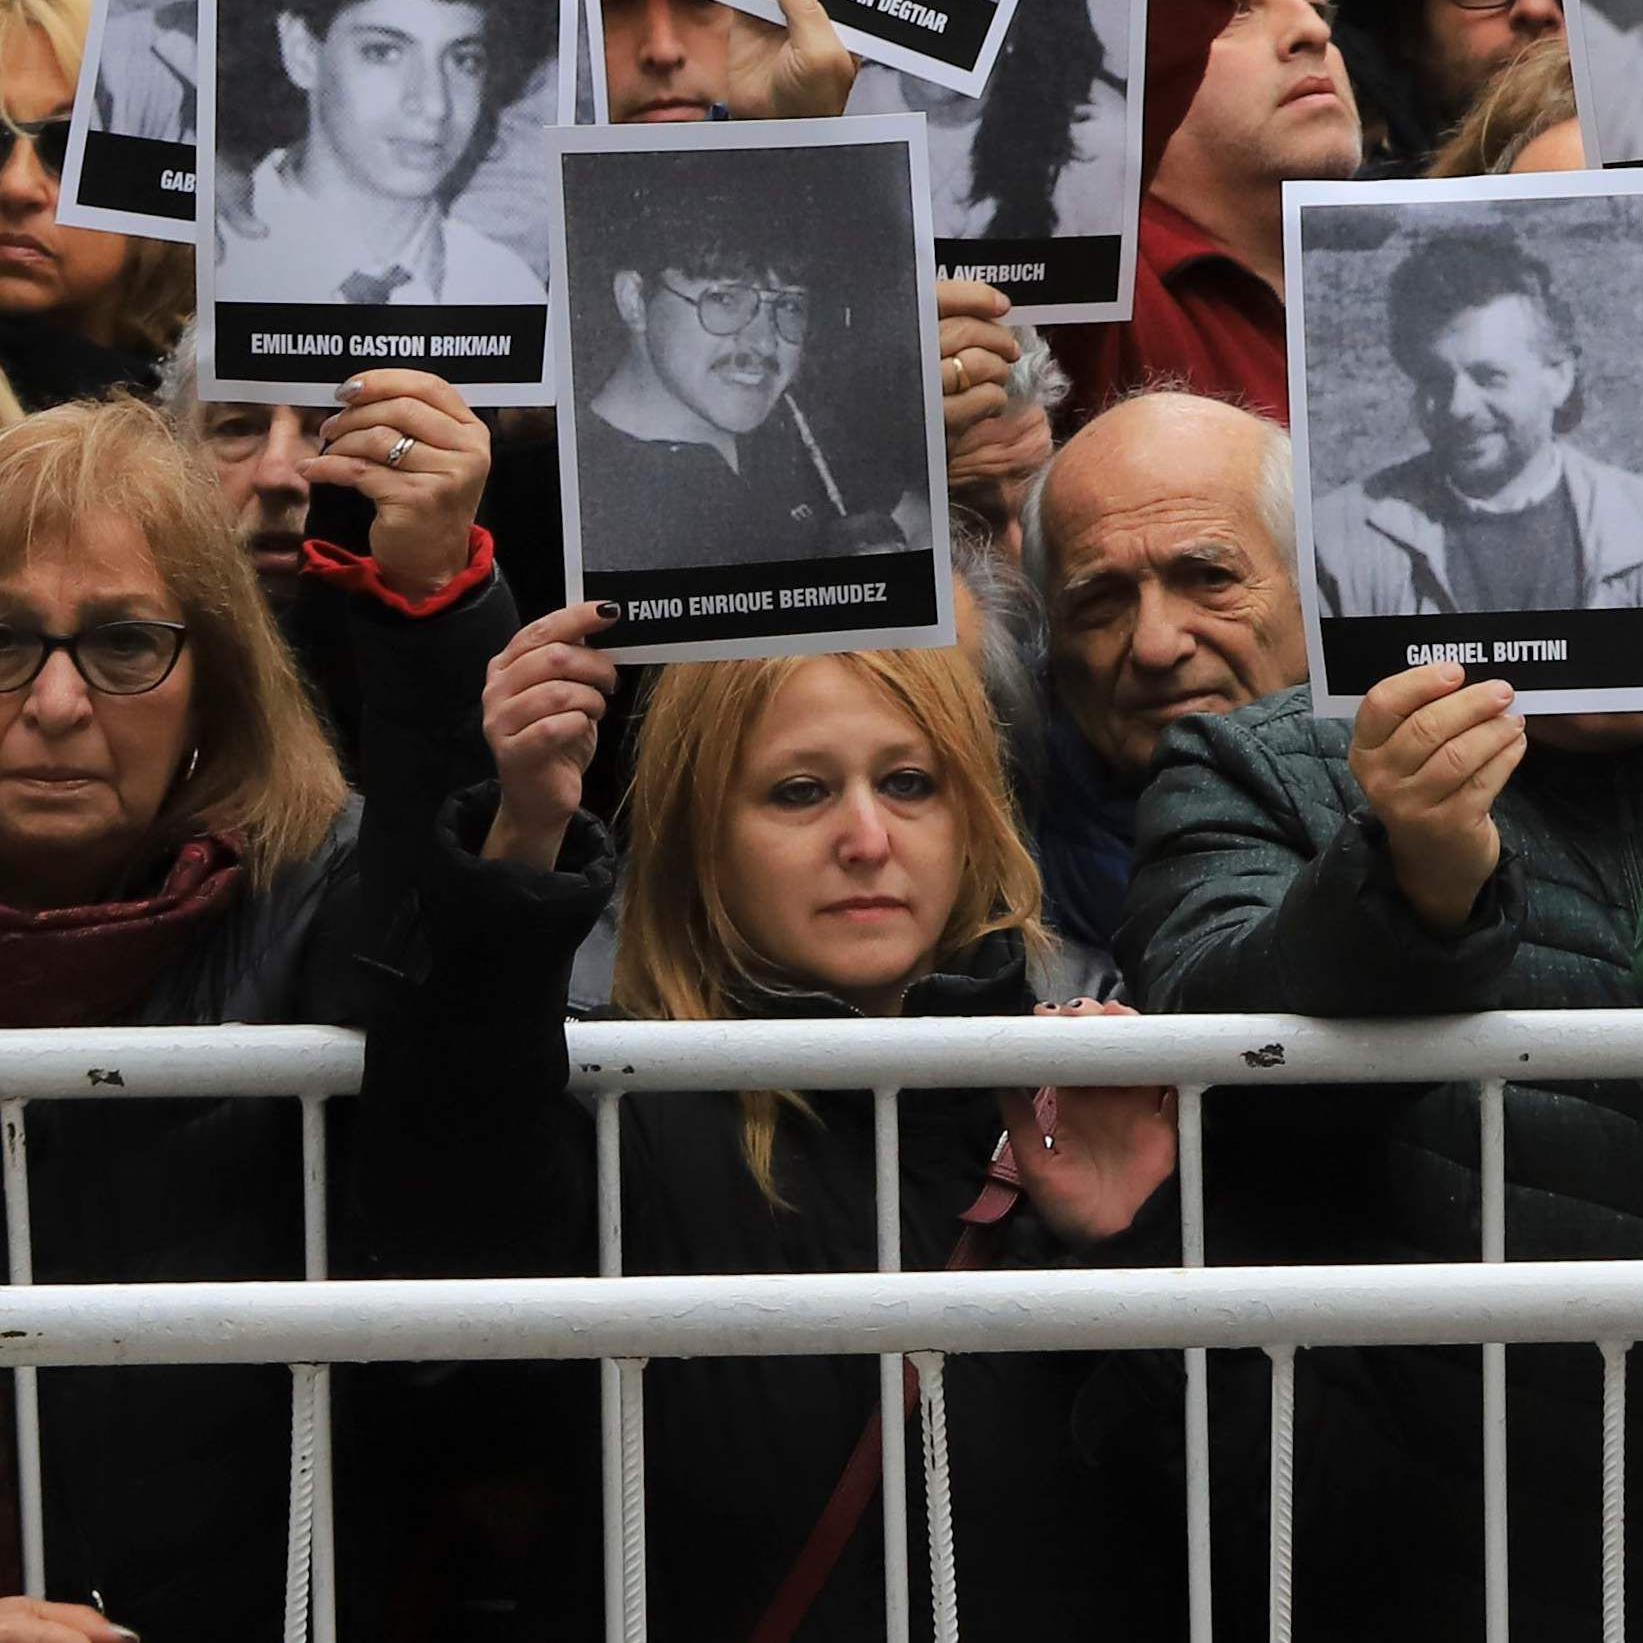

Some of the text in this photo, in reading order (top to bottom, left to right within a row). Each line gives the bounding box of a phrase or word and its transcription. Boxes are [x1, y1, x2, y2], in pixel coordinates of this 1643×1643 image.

[160, 169, 196, 194] GAB
[953, 263, 1045, 284] AVERBUCH
[251, 333, 512, 357] EMILIANO GASTON BRIKMAN
[627, 582, 887, 621] FAVIO ENRIQUE BERMUDEZ
[1406, 639, 1567, 667] GABRIEL BUTTINI
